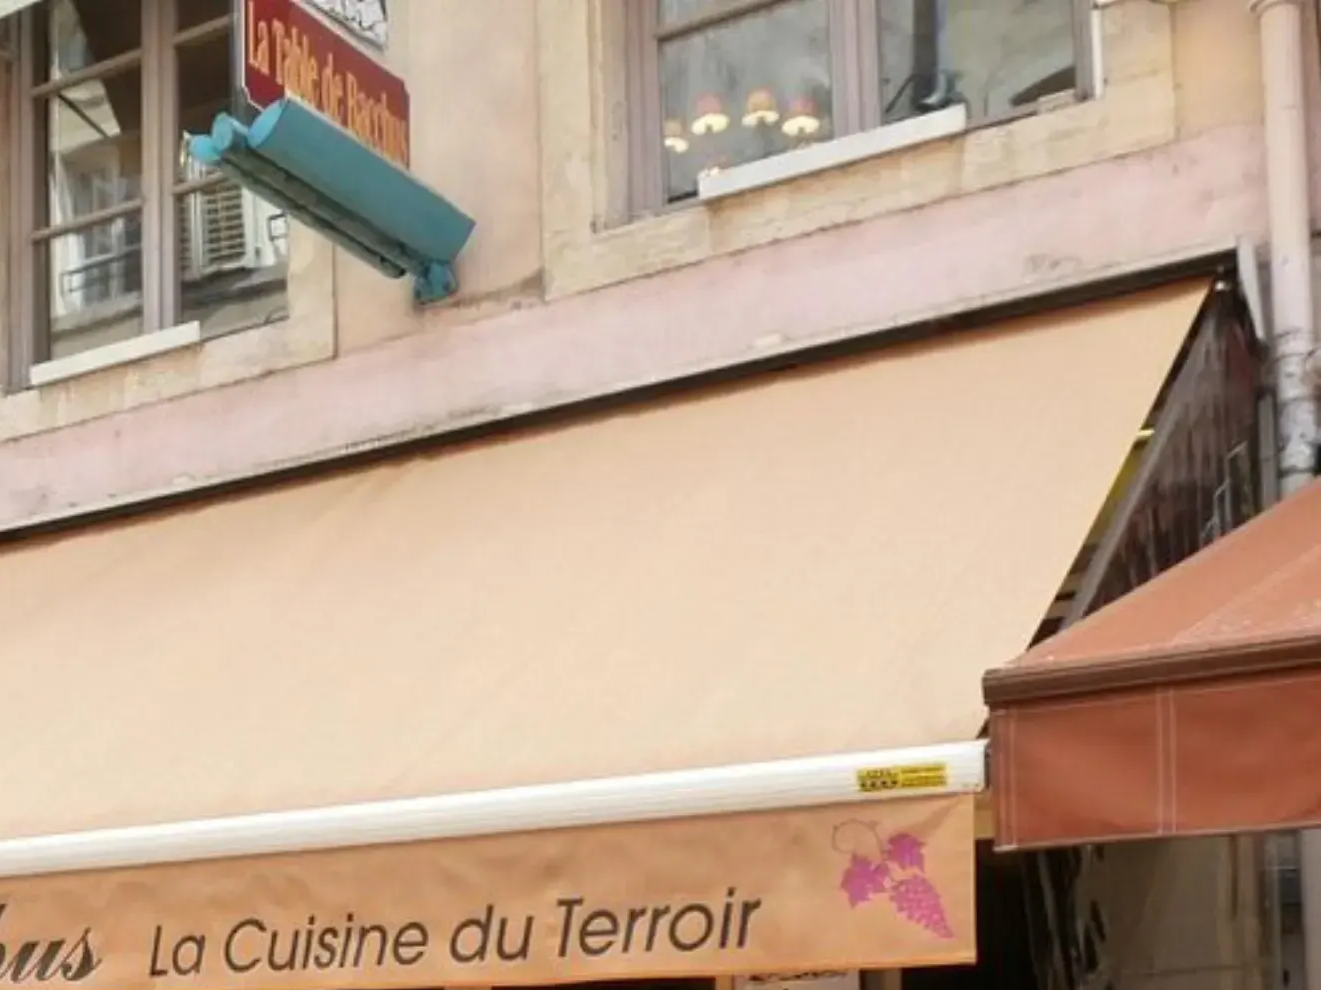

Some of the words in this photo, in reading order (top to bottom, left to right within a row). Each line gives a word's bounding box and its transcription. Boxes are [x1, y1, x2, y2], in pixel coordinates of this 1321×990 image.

[248, 0, 270, 76] La
[271, 18, 321, 110] Table
[321, 52, 346, 121] de
[149, 924, 206, 977] La
[224, 912, 429, 973] Cuisine
[449, 904, 535, 963] du
[556, 887, 762, 957] Terroir
